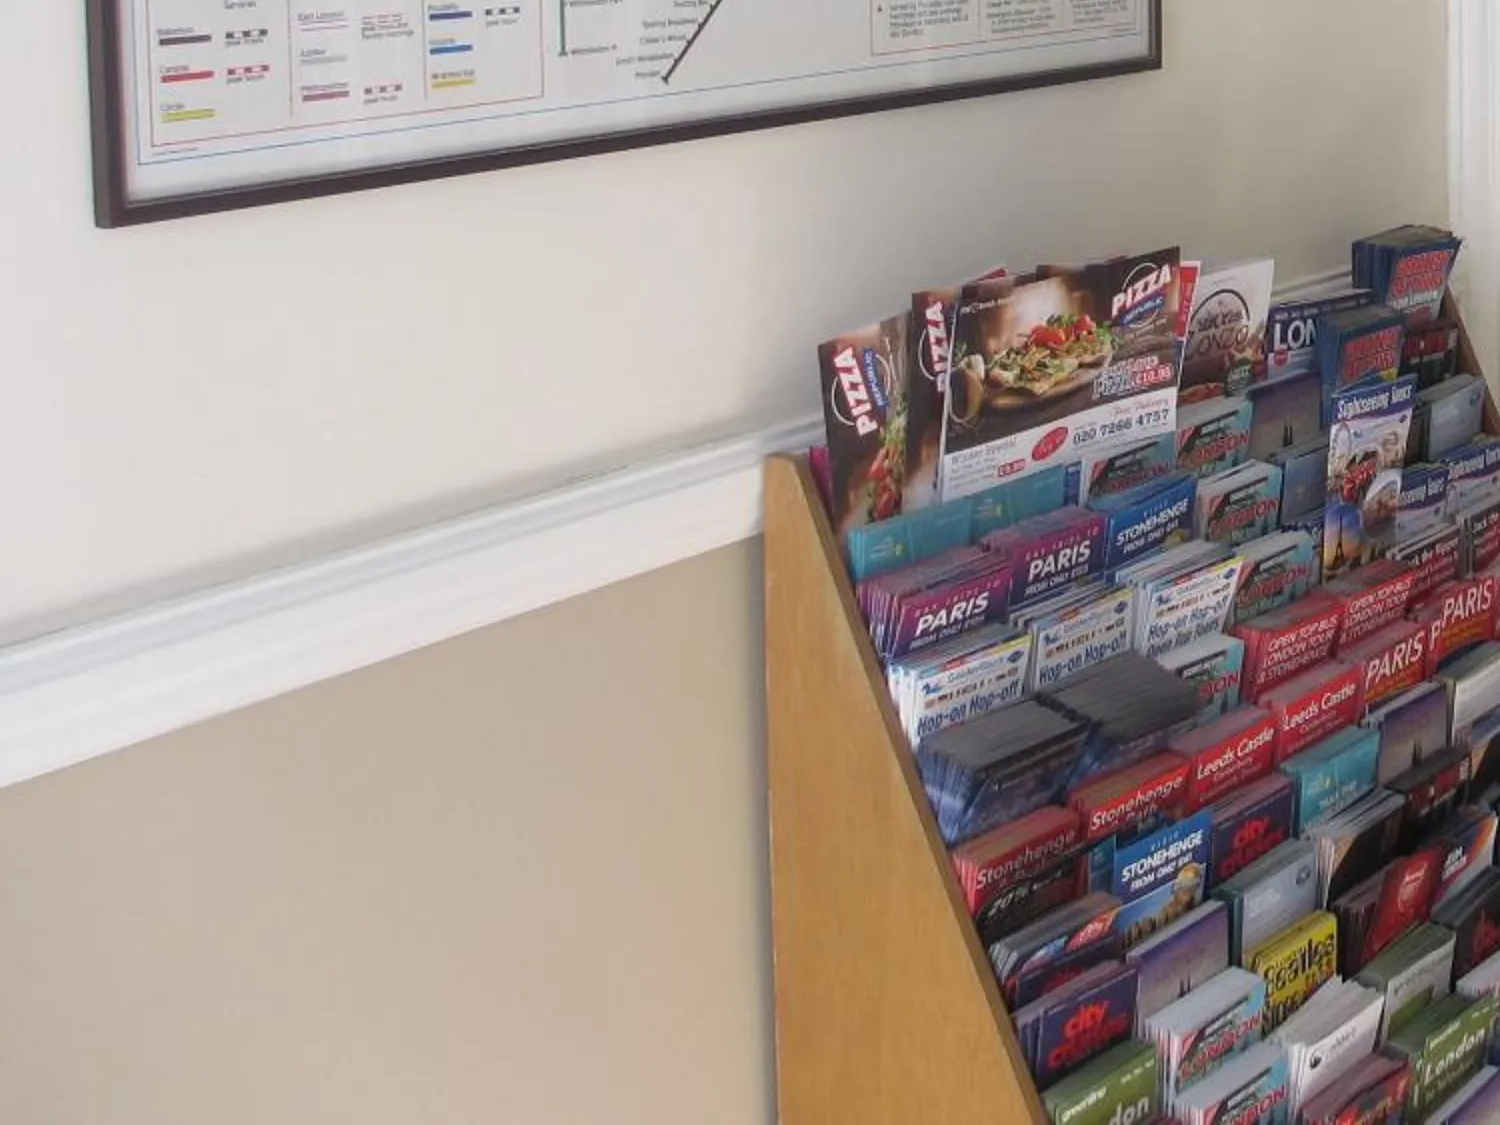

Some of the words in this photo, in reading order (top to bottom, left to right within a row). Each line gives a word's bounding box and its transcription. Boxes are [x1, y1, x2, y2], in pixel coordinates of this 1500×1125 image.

[1112, 264, 1172, 318] PIZZA
[834, 347, 878, 436] PIZZA
[1073, 429, 1096, 444] 020
[1136, 409, 1170, 426] 4757
[1116, 498, 1189, 546] STONEHENGE
[1028, 539, 1091, 582] PARIS
[915, 590, 990, 637] PARIS
[1441, 578, 1493, 628] PARIS
[1040, 653, 1082, 683] Hop-on
[1084, 631, 1126, 663] Hop-off
[1365, 630, 1427, 690] PARIS
[918, 704, 966, 735] Hop-on
[969, 679, 1019, 715] Hop-off
[1282, 702, 1319, 732] Leeds
[1321, 683, 1357, 710] Castle
[1197, 746, 1235, 779] Leeds
[1237, 727, 1276, 757] Castle
[1090, 775, 1184, 831] Stonehenge
[976, 828, 1077, 890] Stonehenge
[1121, 827, 1204, 883] STONEHENGE
[1129, 875, 1156, 893] FROM
